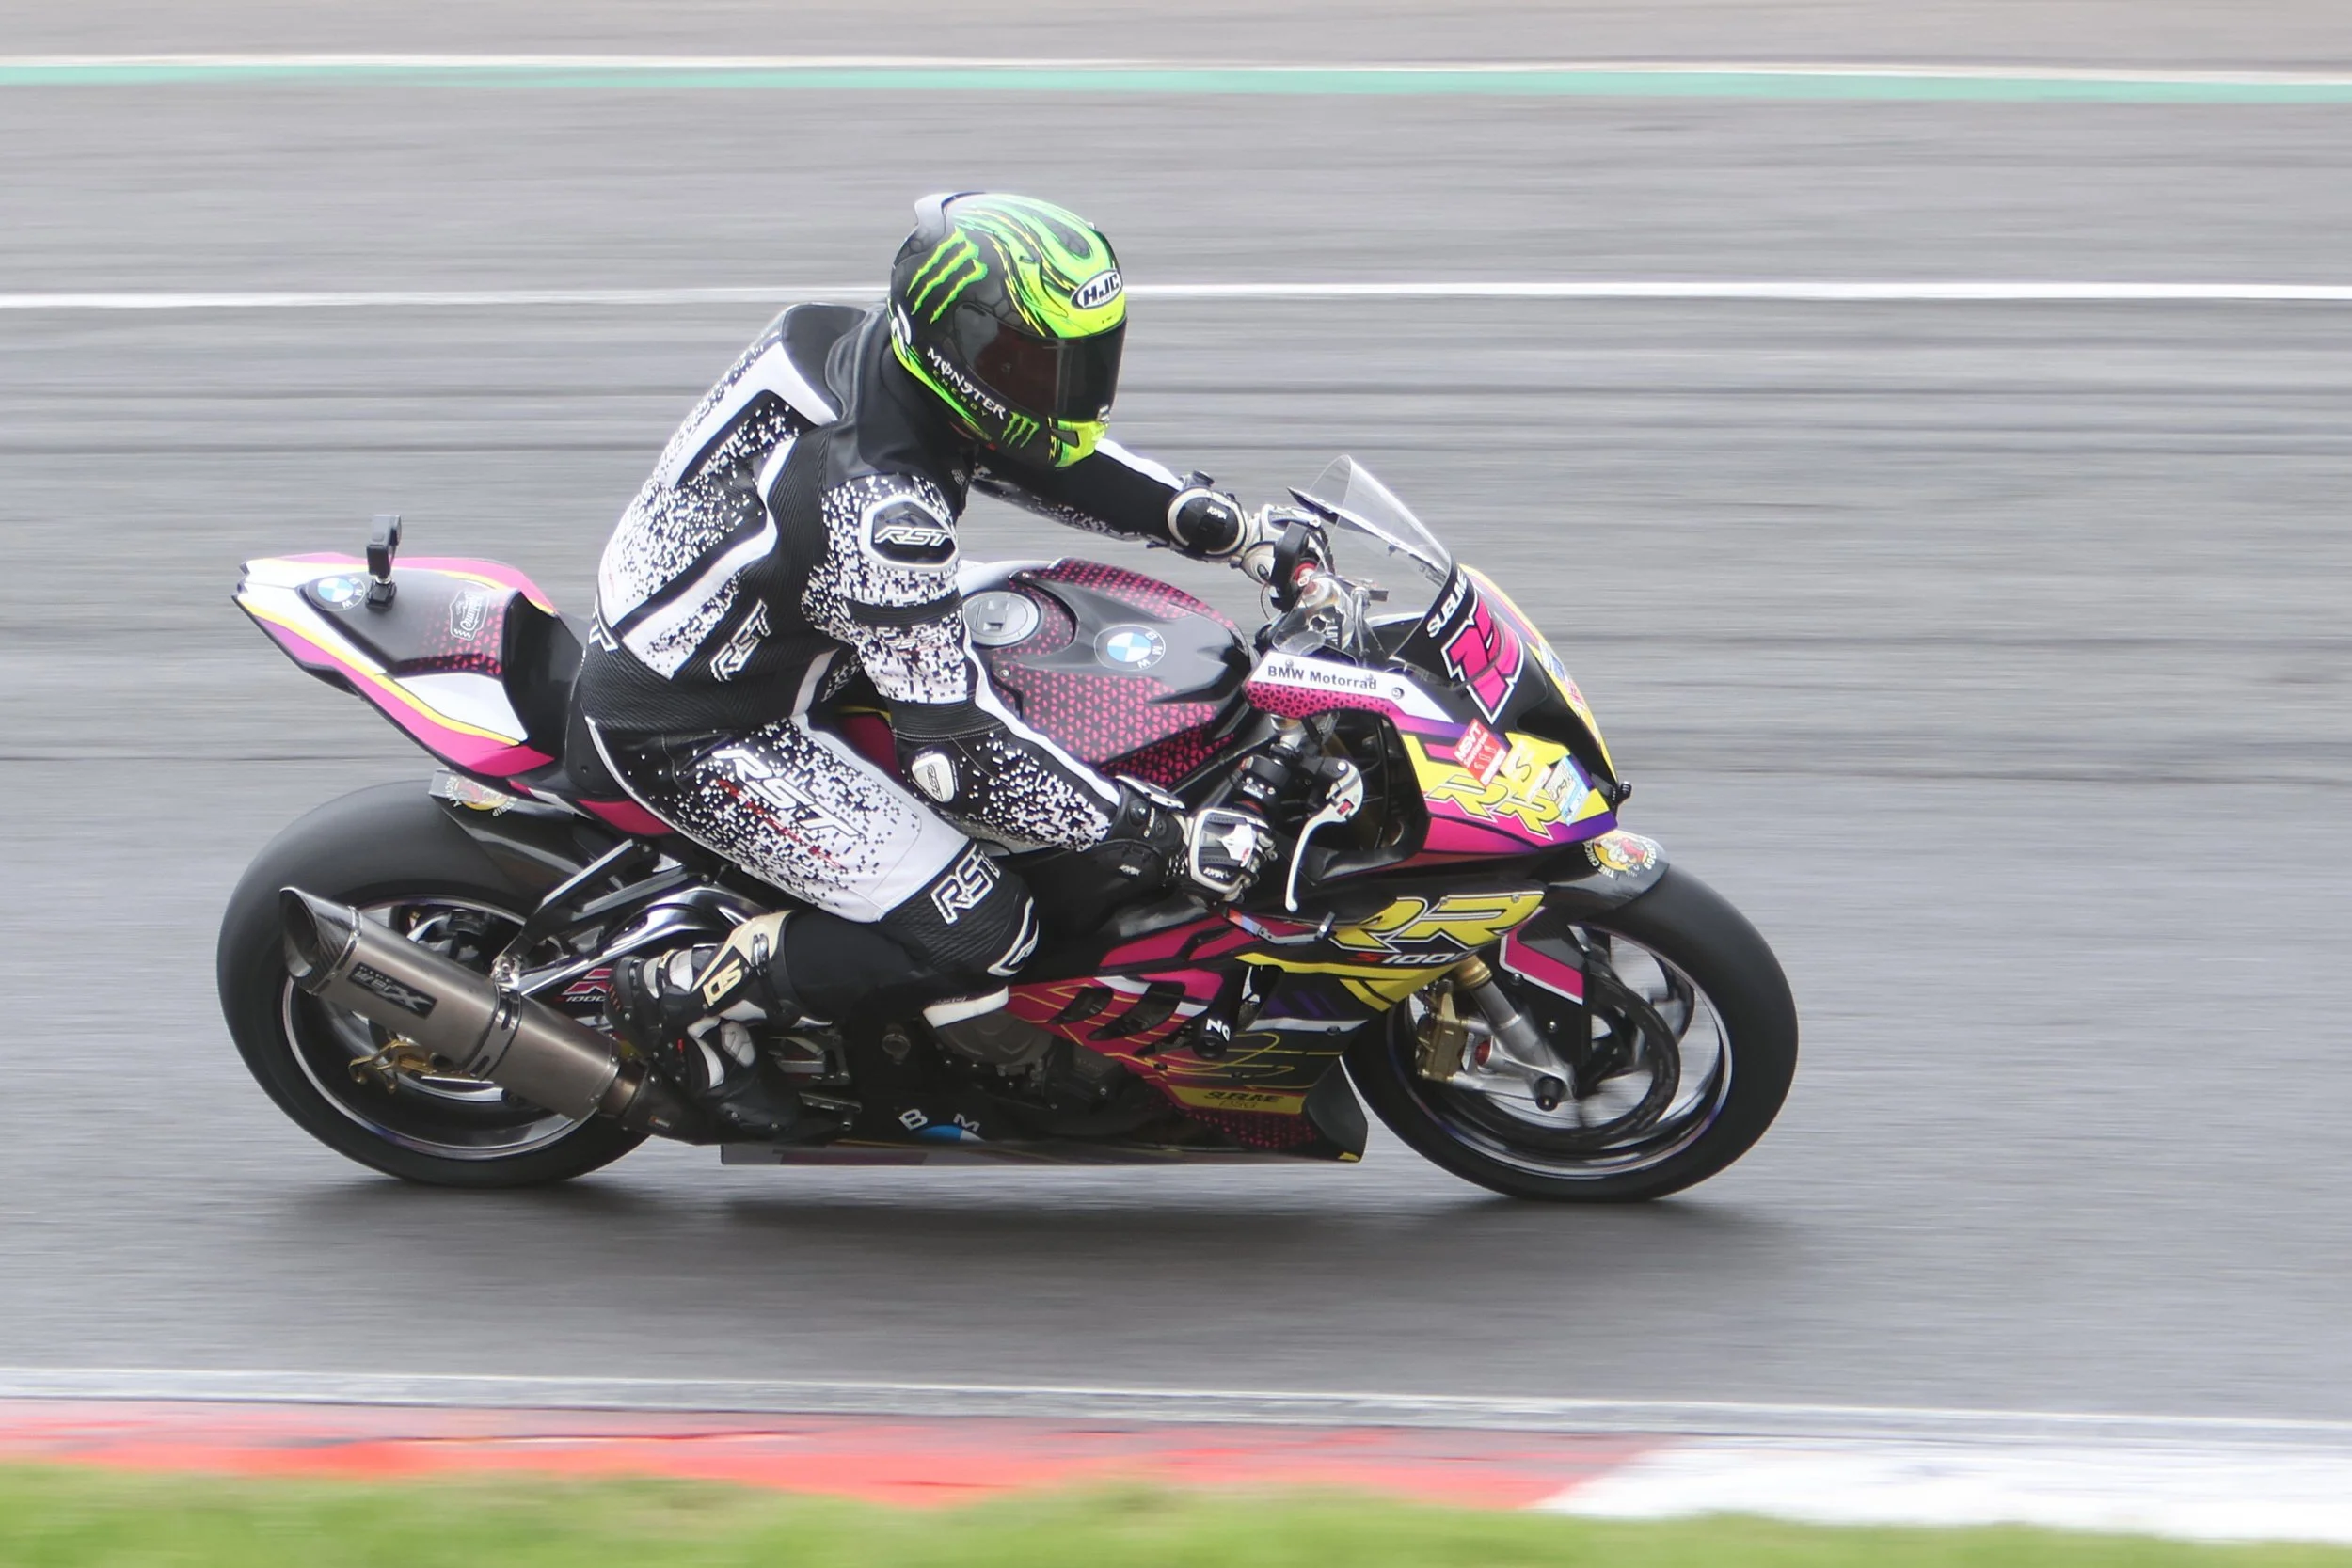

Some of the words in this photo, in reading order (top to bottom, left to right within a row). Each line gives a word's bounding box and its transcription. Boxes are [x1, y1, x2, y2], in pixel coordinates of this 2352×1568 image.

[1083, 274, 1119, 307] HJC
[927, 345, 1006, 420] MONSTER
[932, 370, 988, 417] ENERGY
[874, 525, 951, 546] RST
[710, 598, 771, 682] RST
[1267, 665, 1305, 680] BMW
[1309, 671, 1377, 690] Motorrad
[712, 749, 864, 840] RST
[930, 843, 1000, 925] RST
[1329, 891, 1545, 954] RR
[898, 1108, 980, 1132] BM
